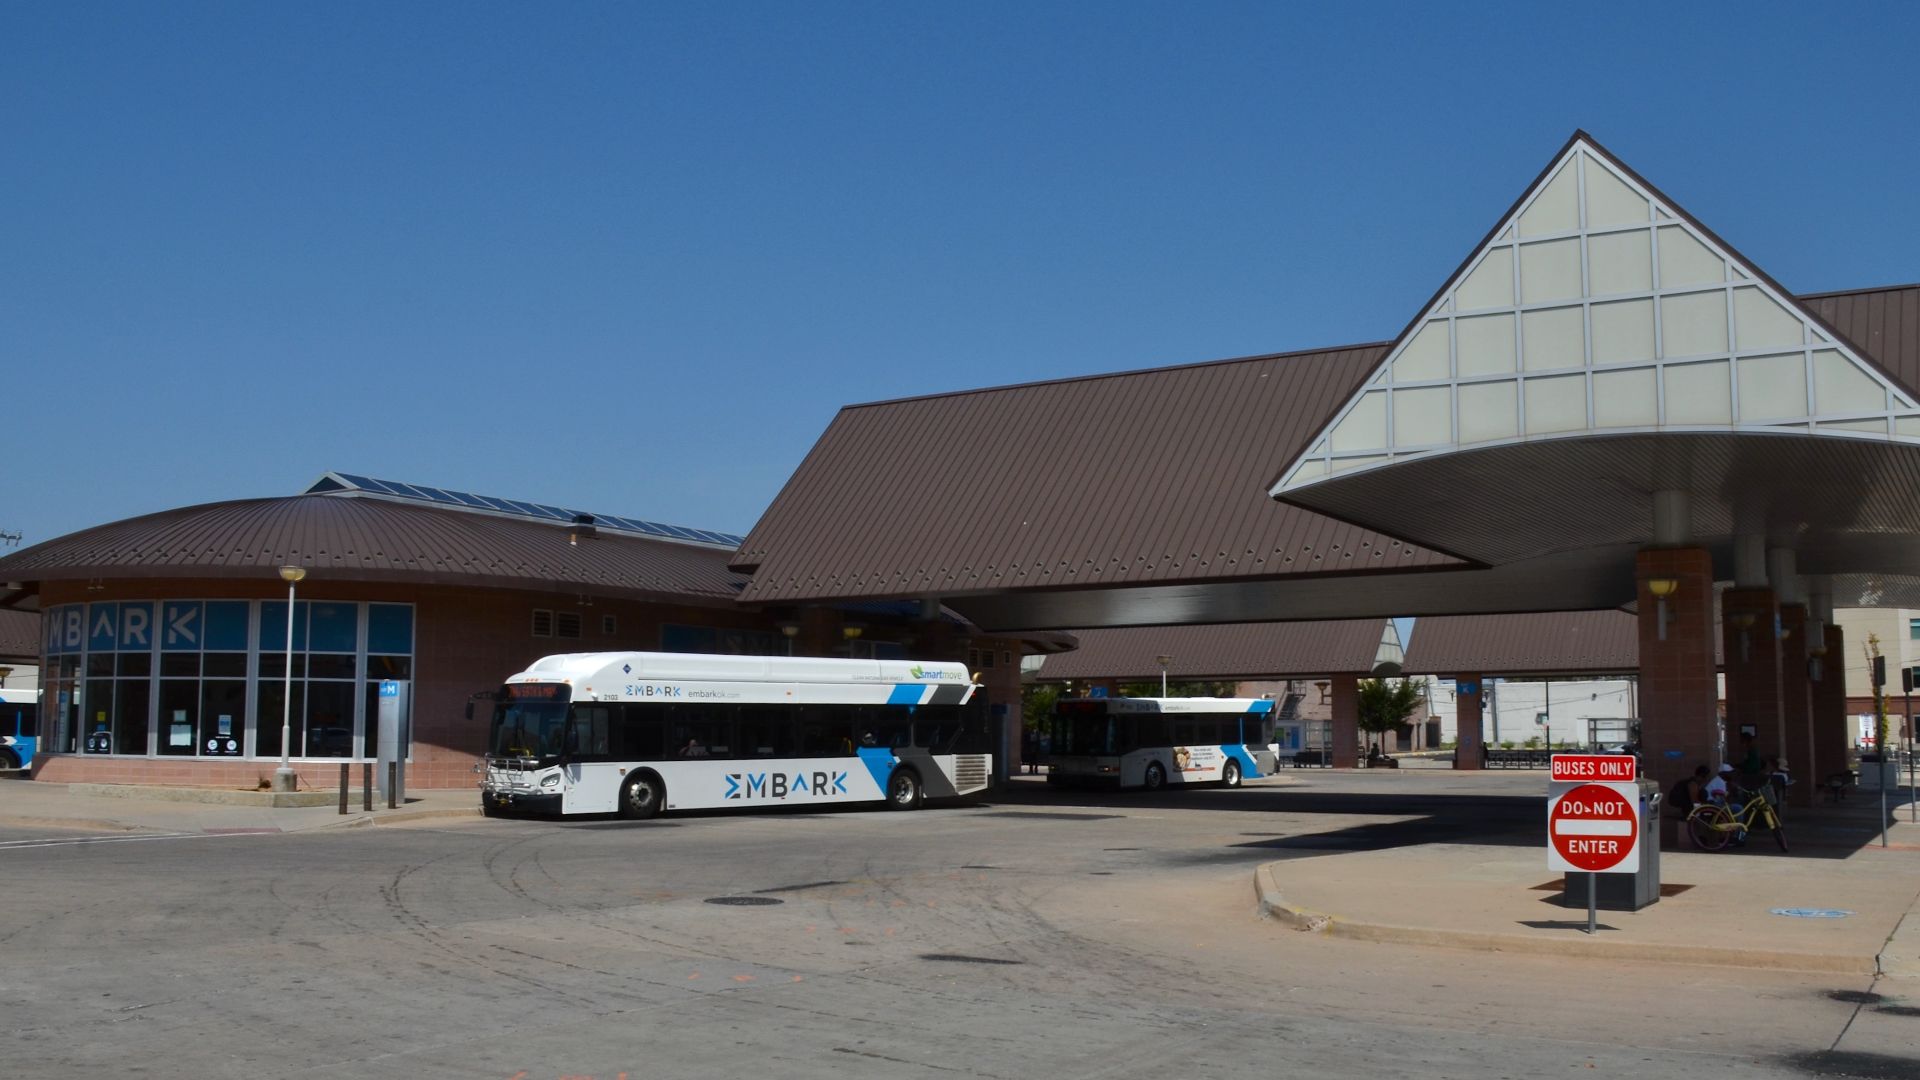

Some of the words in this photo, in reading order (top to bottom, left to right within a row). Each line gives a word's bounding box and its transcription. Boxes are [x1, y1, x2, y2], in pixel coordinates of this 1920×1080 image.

[44, 607, 198, 648] MBARK
[625, 685, 681, 697] EMBARK
[1553, 761, 1595, 775] BUSES
[1600, 762, 1632, 776] ONLY
[725, 771, 848, 800] EMBARK
[1562, 801, 1583, 815] DO
[1593, 801, 1625, 816] NOT
[1568, 839, 1618, 854] ENTER
